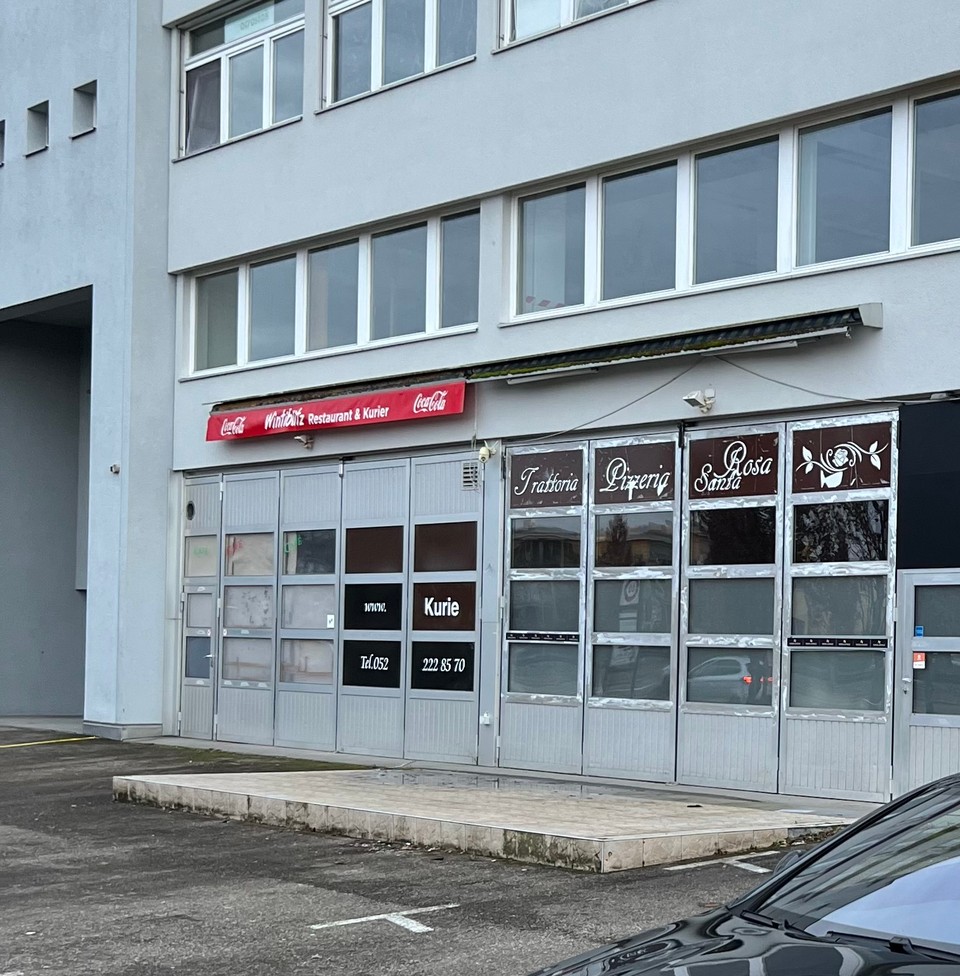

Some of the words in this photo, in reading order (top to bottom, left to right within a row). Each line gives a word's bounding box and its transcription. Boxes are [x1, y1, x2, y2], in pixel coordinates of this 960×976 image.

[307, 411, 353, 425] Restaurant
[354, 409, 361, 421] &
[362, 405, 390, 420] Kurier
[713, 440, 773, 479] Rosa
[513, 466, 579, 496] Trattoria
[599, 457, 671, 501] Pizzeria
[694, 463, 742, 493] Santa
[364, 602, 387, 613] www.
[424, 597, 460, 617] Kurie
[421, 657, 439, 672] 222
[440, 657, 452, 672] 85
[453, 657, 466, 673] 70
